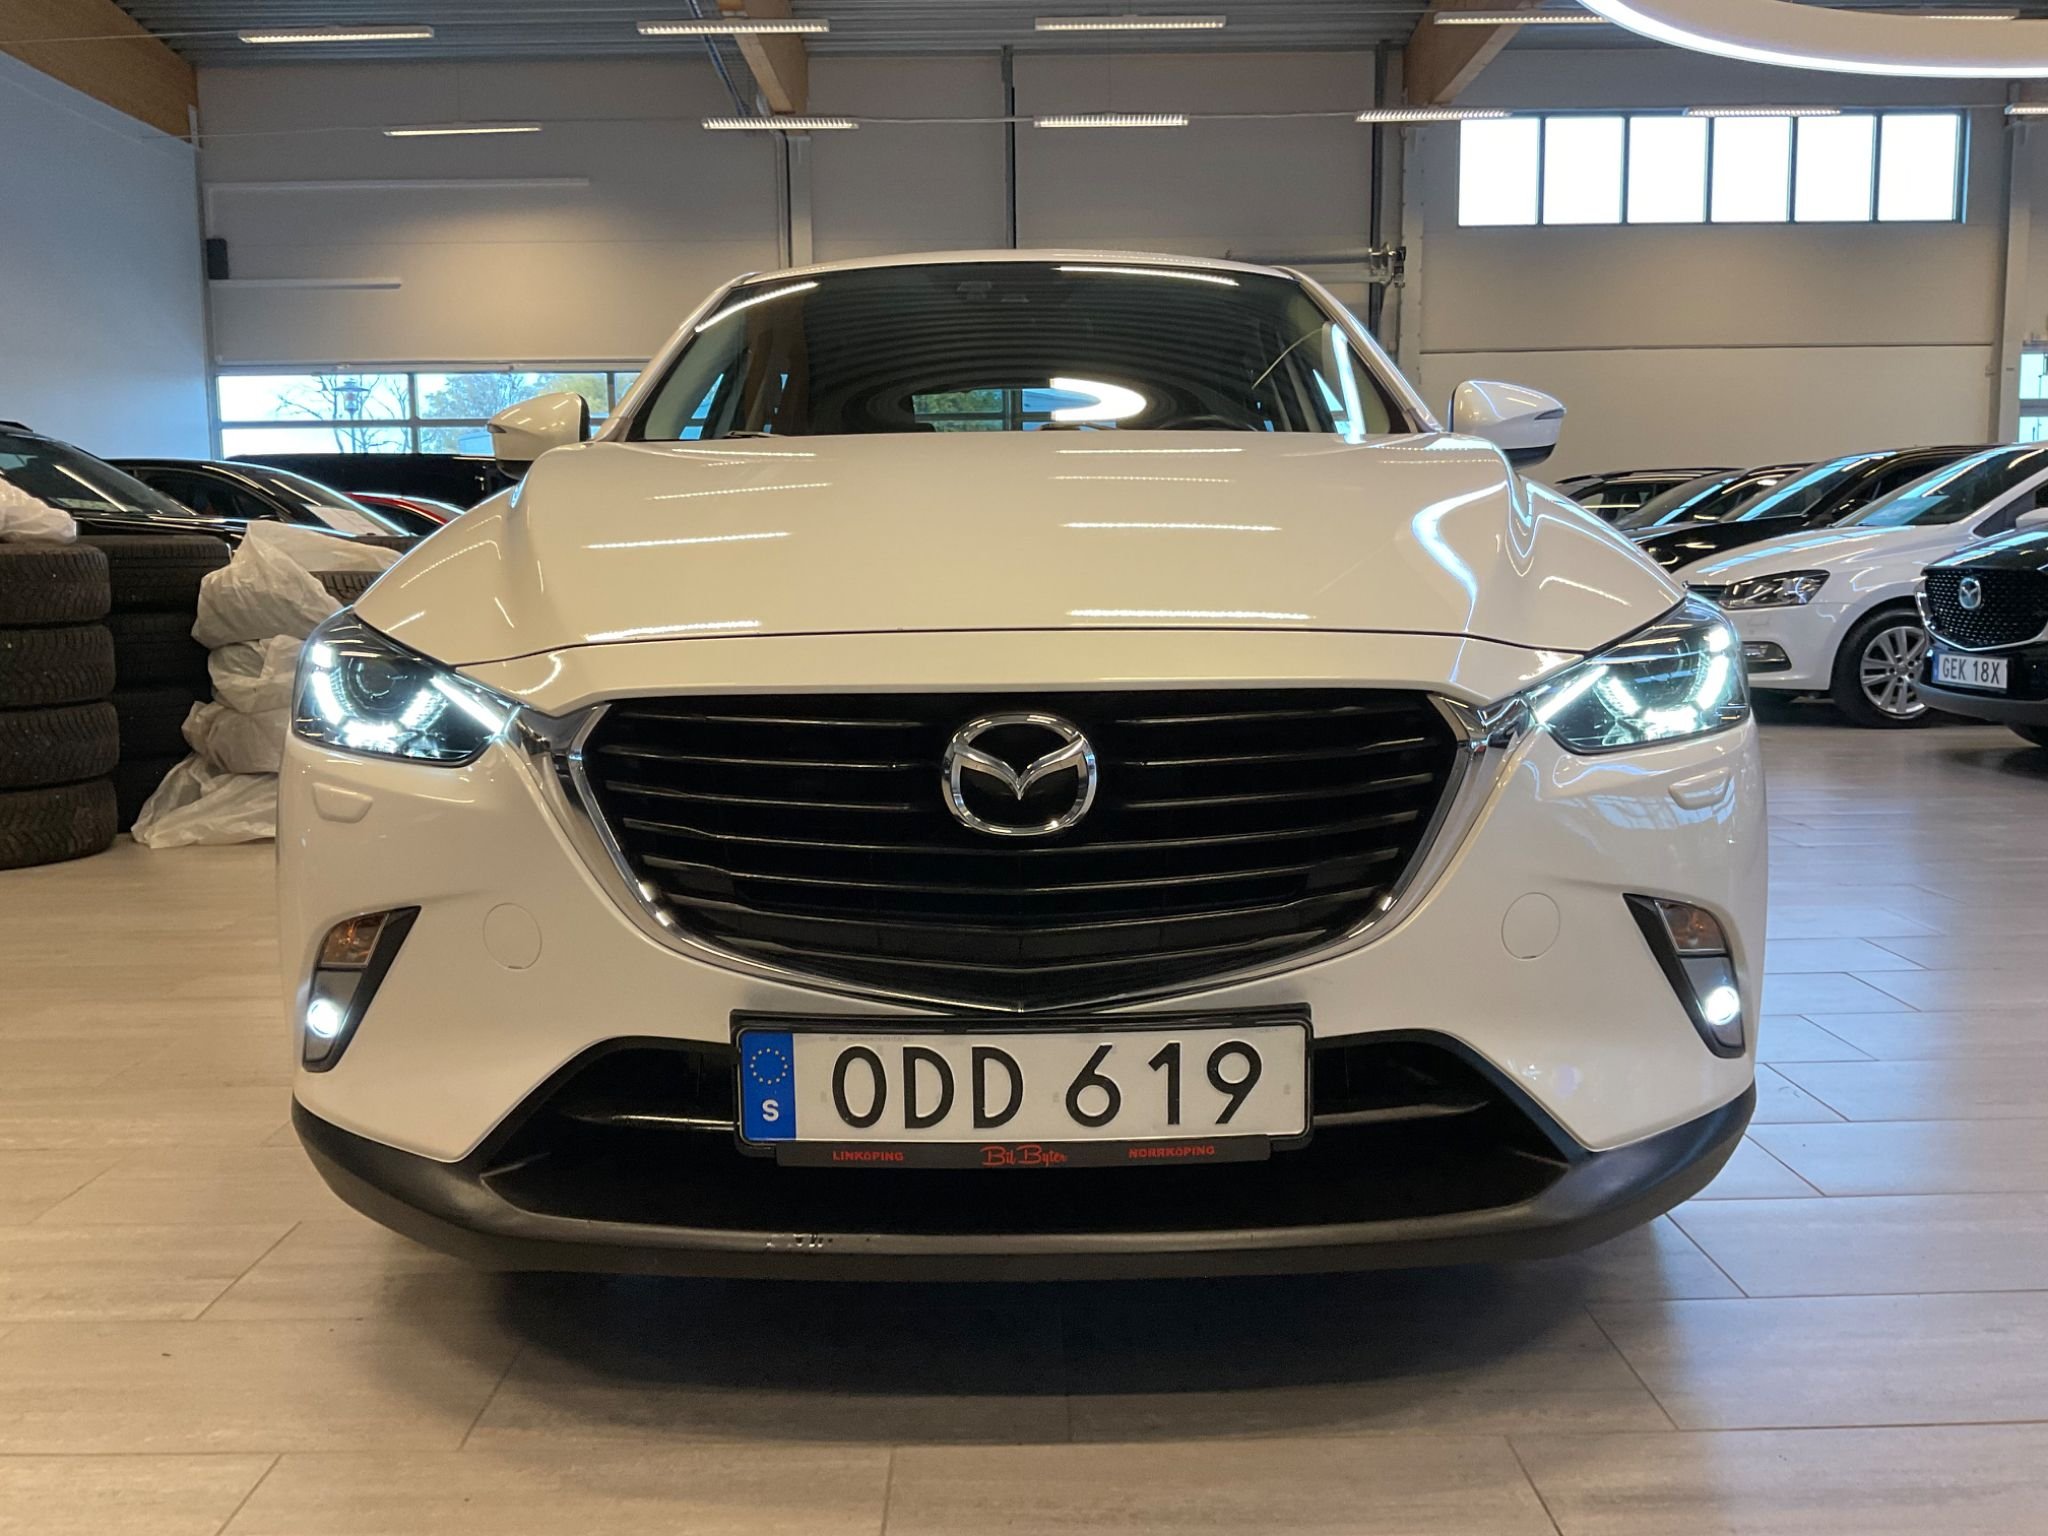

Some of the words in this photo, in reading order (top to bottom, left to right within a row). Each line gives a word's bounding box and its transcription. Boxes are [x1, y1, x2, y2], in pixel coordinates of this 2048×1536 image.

[1942, 658, 1967, 681] GEK
[1973, 660, 2000, 685] 18X
[831, 1044, 1024, 1129] ODD
[1065, 1040, 1263, 1128] 619
[762, 1099, 780, 1122] S
[979, 1145, 1016, 1166] Bil
